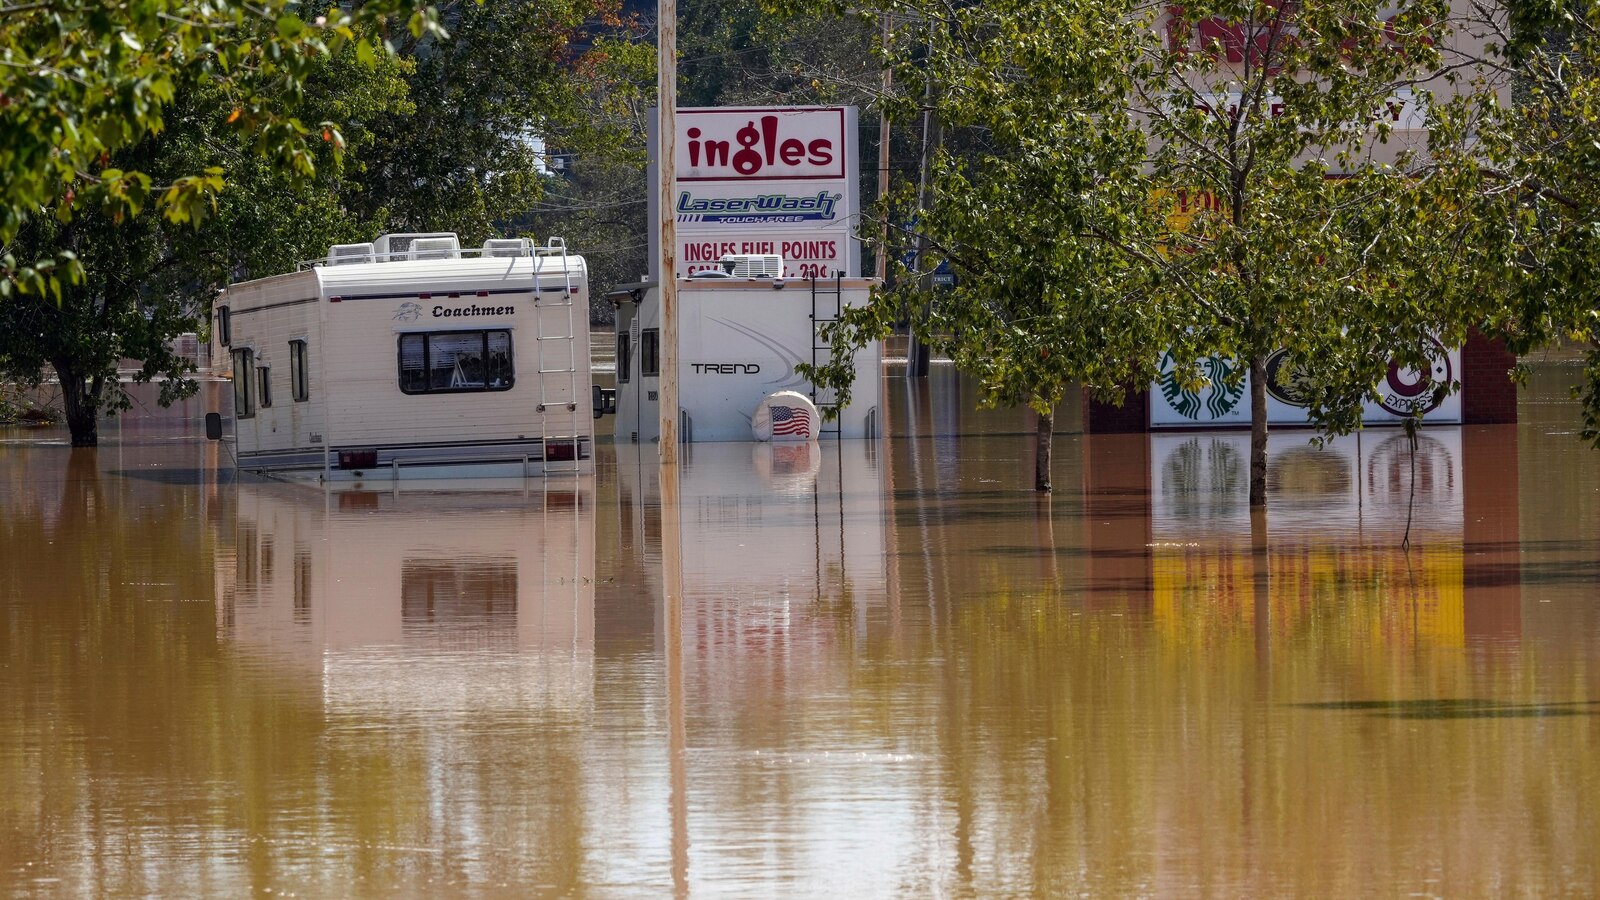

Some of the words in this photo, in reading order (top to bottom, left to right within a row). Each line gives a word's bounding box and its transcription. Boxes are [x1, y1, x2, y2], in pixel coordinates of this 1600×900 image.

[687, 115, 833, 175] ingles
[719, 215, 764, 224] TOUCH
[766, 215, 804, 223] FREE
[684, 242, 737, 261] INGLES
[781, 240, 837, 260] POINTS
[432, 304, 515, 318] Coachmen
[691, 363, 761, 375] TREND
